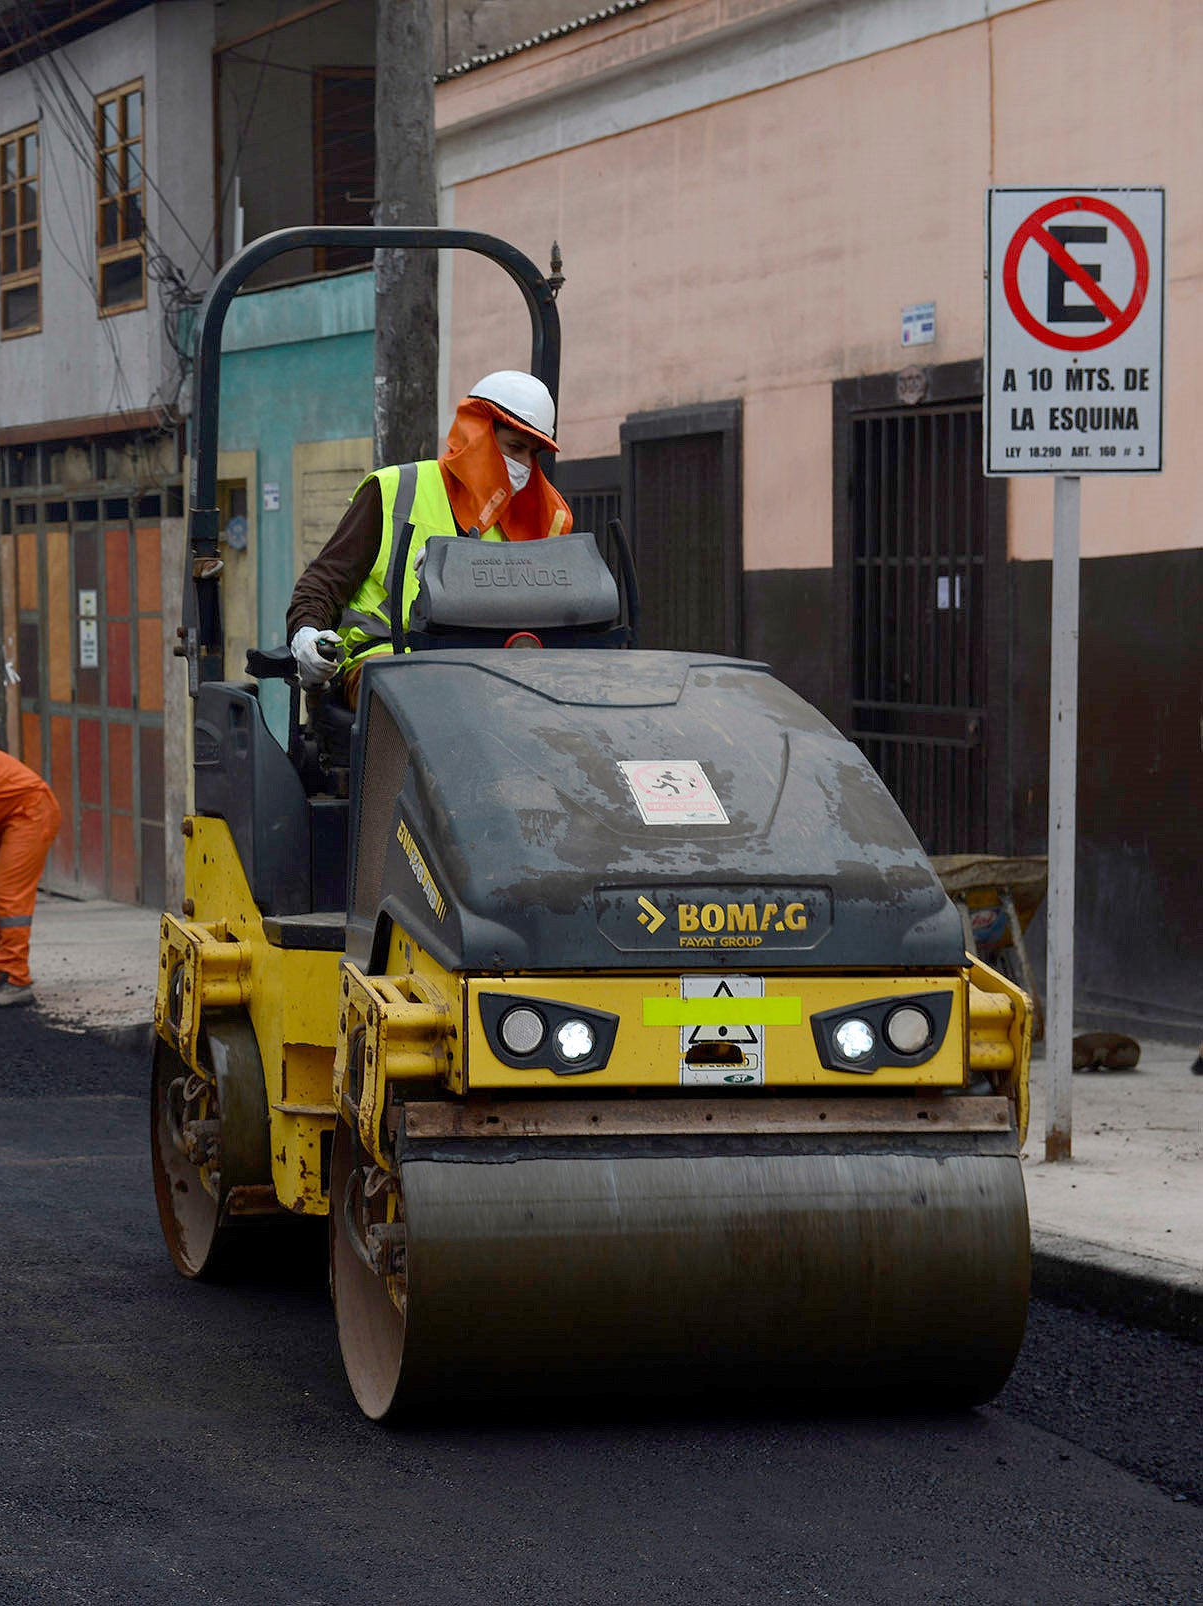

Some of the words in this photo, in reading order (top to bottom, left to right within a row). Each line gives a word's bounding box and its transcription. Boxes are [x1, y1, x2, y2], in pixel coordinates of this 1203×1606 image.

[1047, 226, 1107, 322] E
[1002, 368, 1017, 392] A
[1028, 368, 1053, 391] 10
[1065, 368, 1115, 391] MTS.
[1124, 368, 1149, 391] DE
[1010, 407, 1035, 431] LA
[1049, 407, 1139, 433] ESQUINA
[1005, 447, 1021, 458] LEY
[1029, 447, 1061, 457] 18.290
[1071, 447, 1092, 457] ART.
[1100, 446, 1116, 456] 160
[1138, 446, 1144, 456] 3
[471, 567, 573, 587] BOMAG
[678, 903, 807, 932] BOMAG
[679, 937, 716, 947] FAYAT
[720, 936, 763, 947] GROUP
